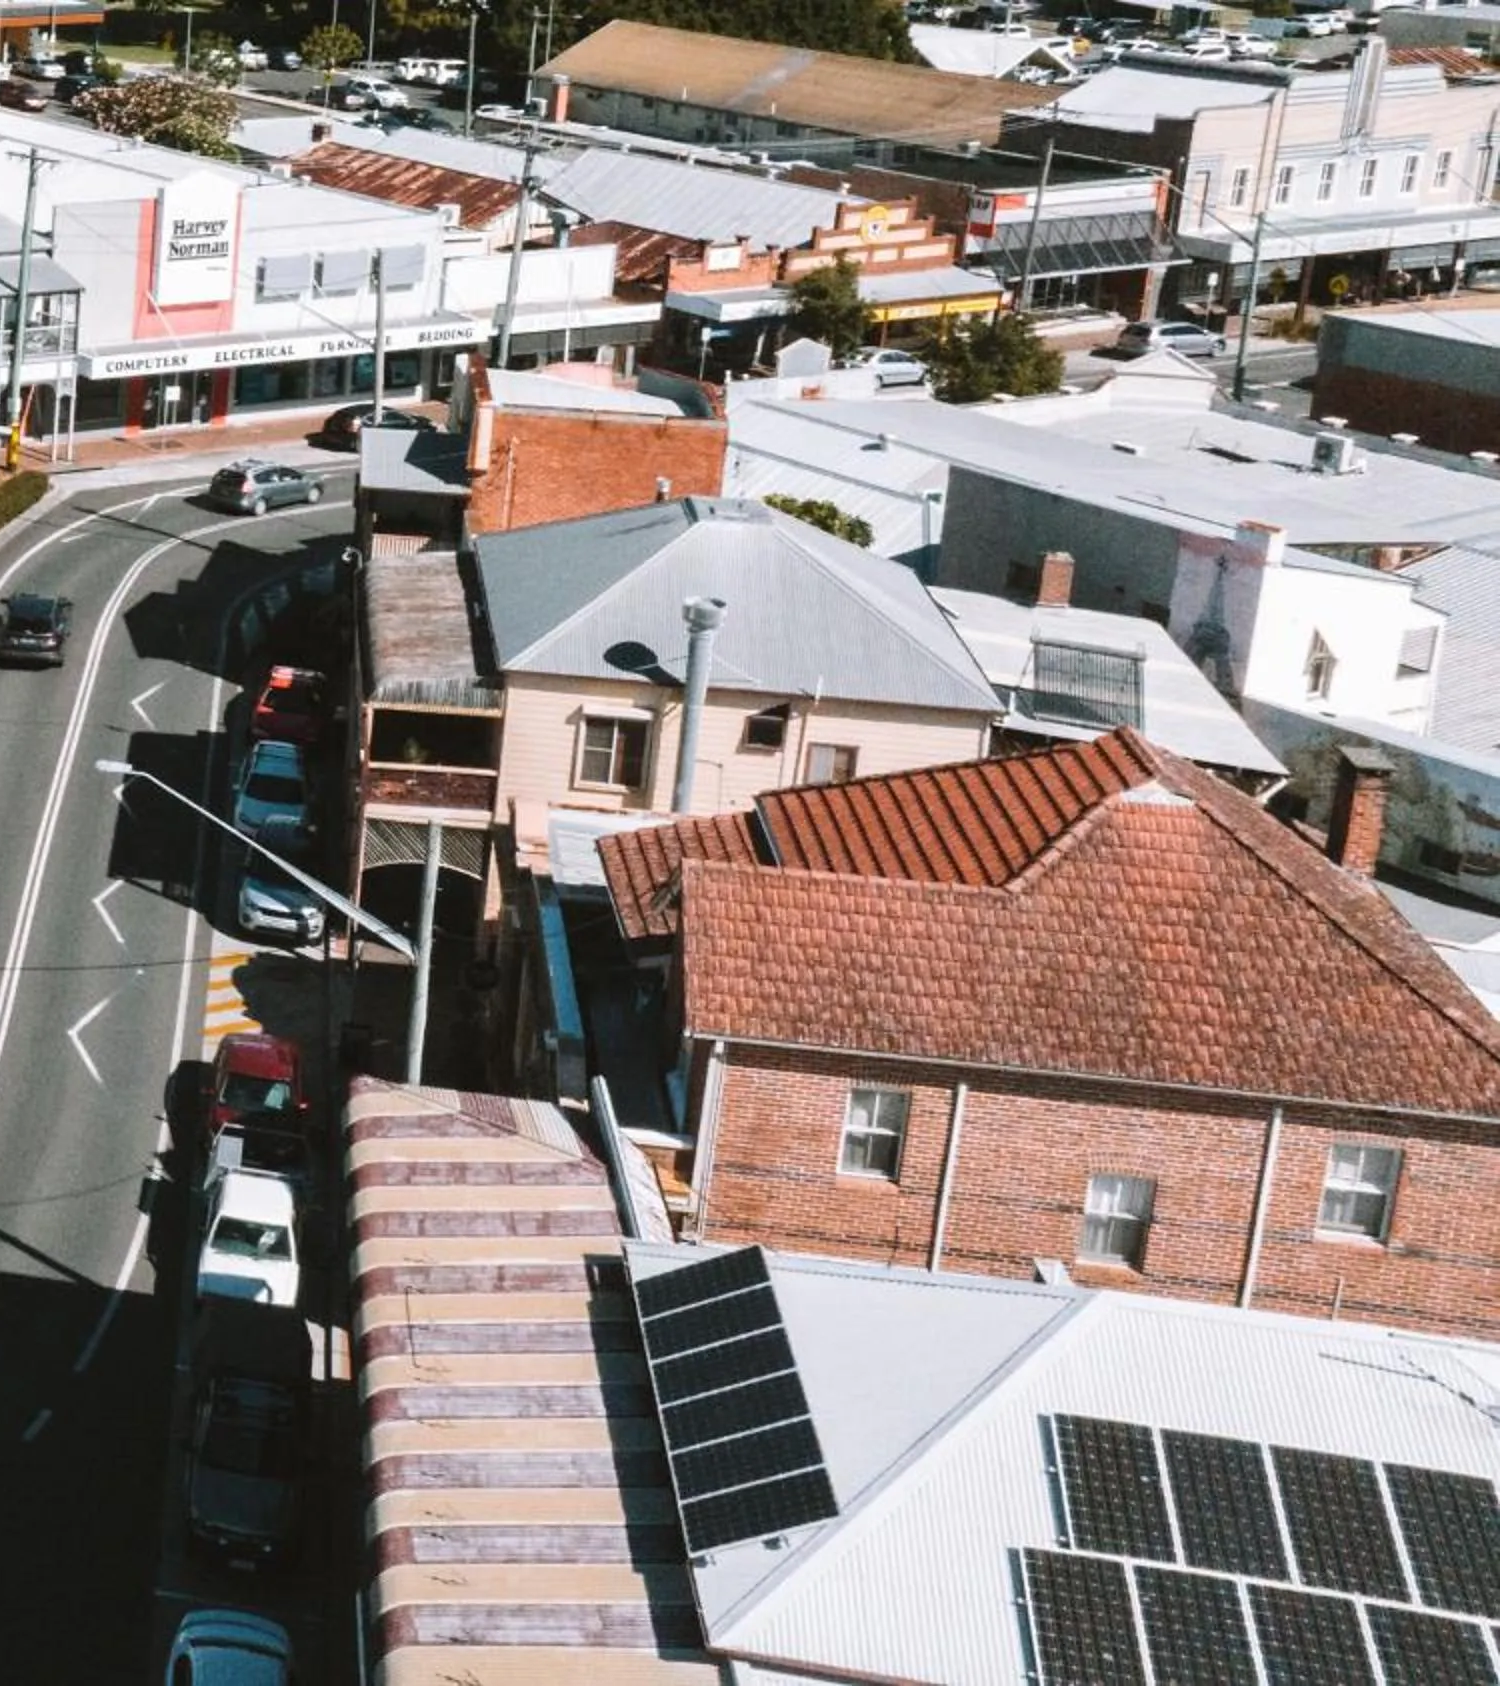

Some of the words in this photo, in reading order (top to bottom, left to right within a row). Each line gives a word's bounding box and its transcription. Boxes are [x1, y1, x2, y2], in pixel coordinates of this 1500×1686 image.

[173, 219, 228, 236] Harvey
[169, 240, 229, 257] Norman
[105, 354, 189, 373] COMPUTERS
[214, 345, 296, 363] ELECTRICAL
[418, 327, 474, 343] BEDDING
